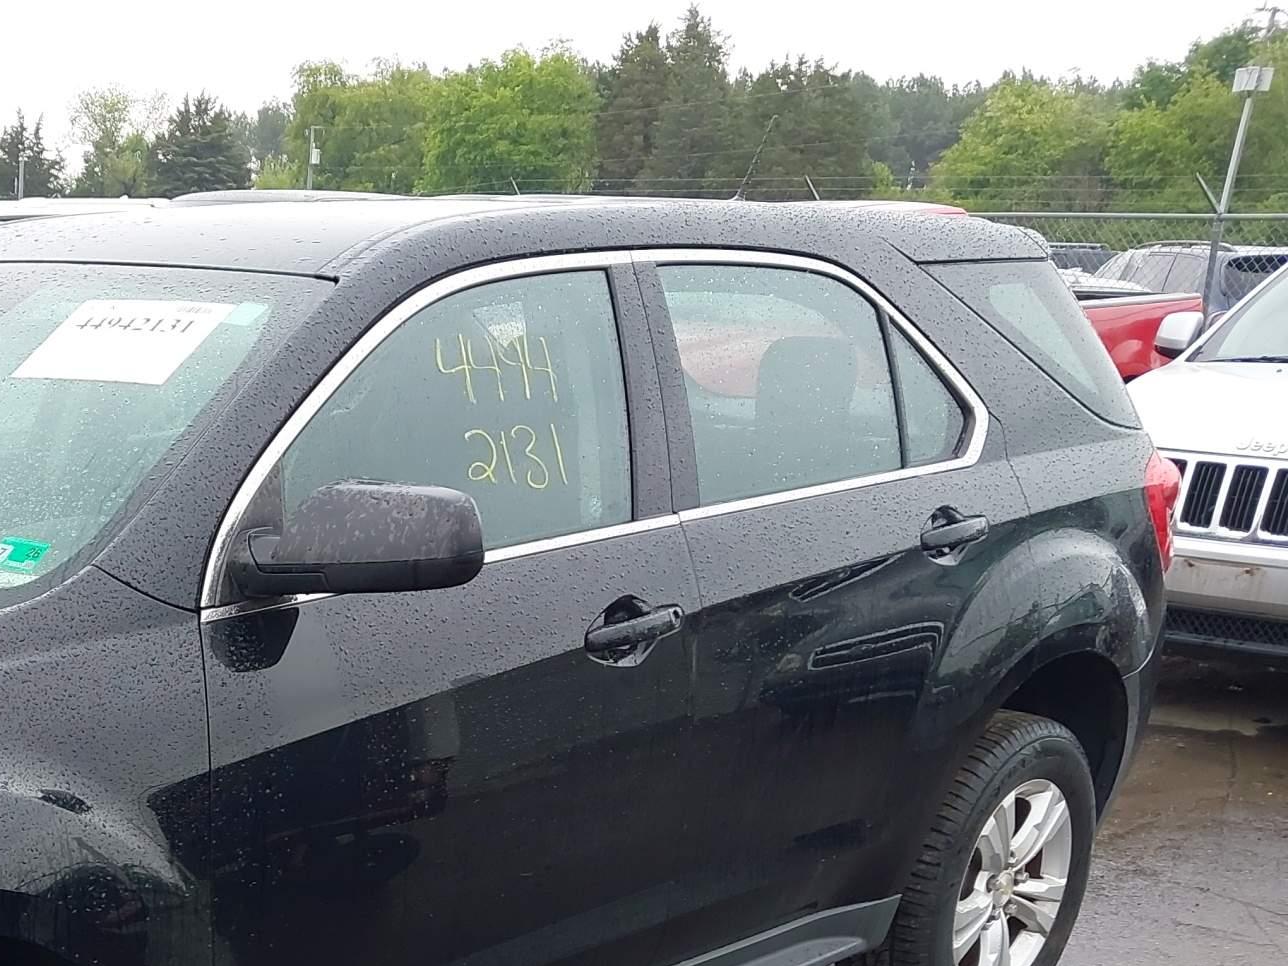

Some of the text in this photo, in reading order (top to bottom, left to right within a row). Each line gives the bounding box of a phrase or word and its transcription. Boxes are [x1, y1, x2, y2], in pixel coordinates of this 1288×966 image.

[76, 317, 194, 332] 44942131
[1237, 437, 1288, 456] Jeep
[464, 423, 569, 489] 2131
[24, 546, 43, 560] 26
